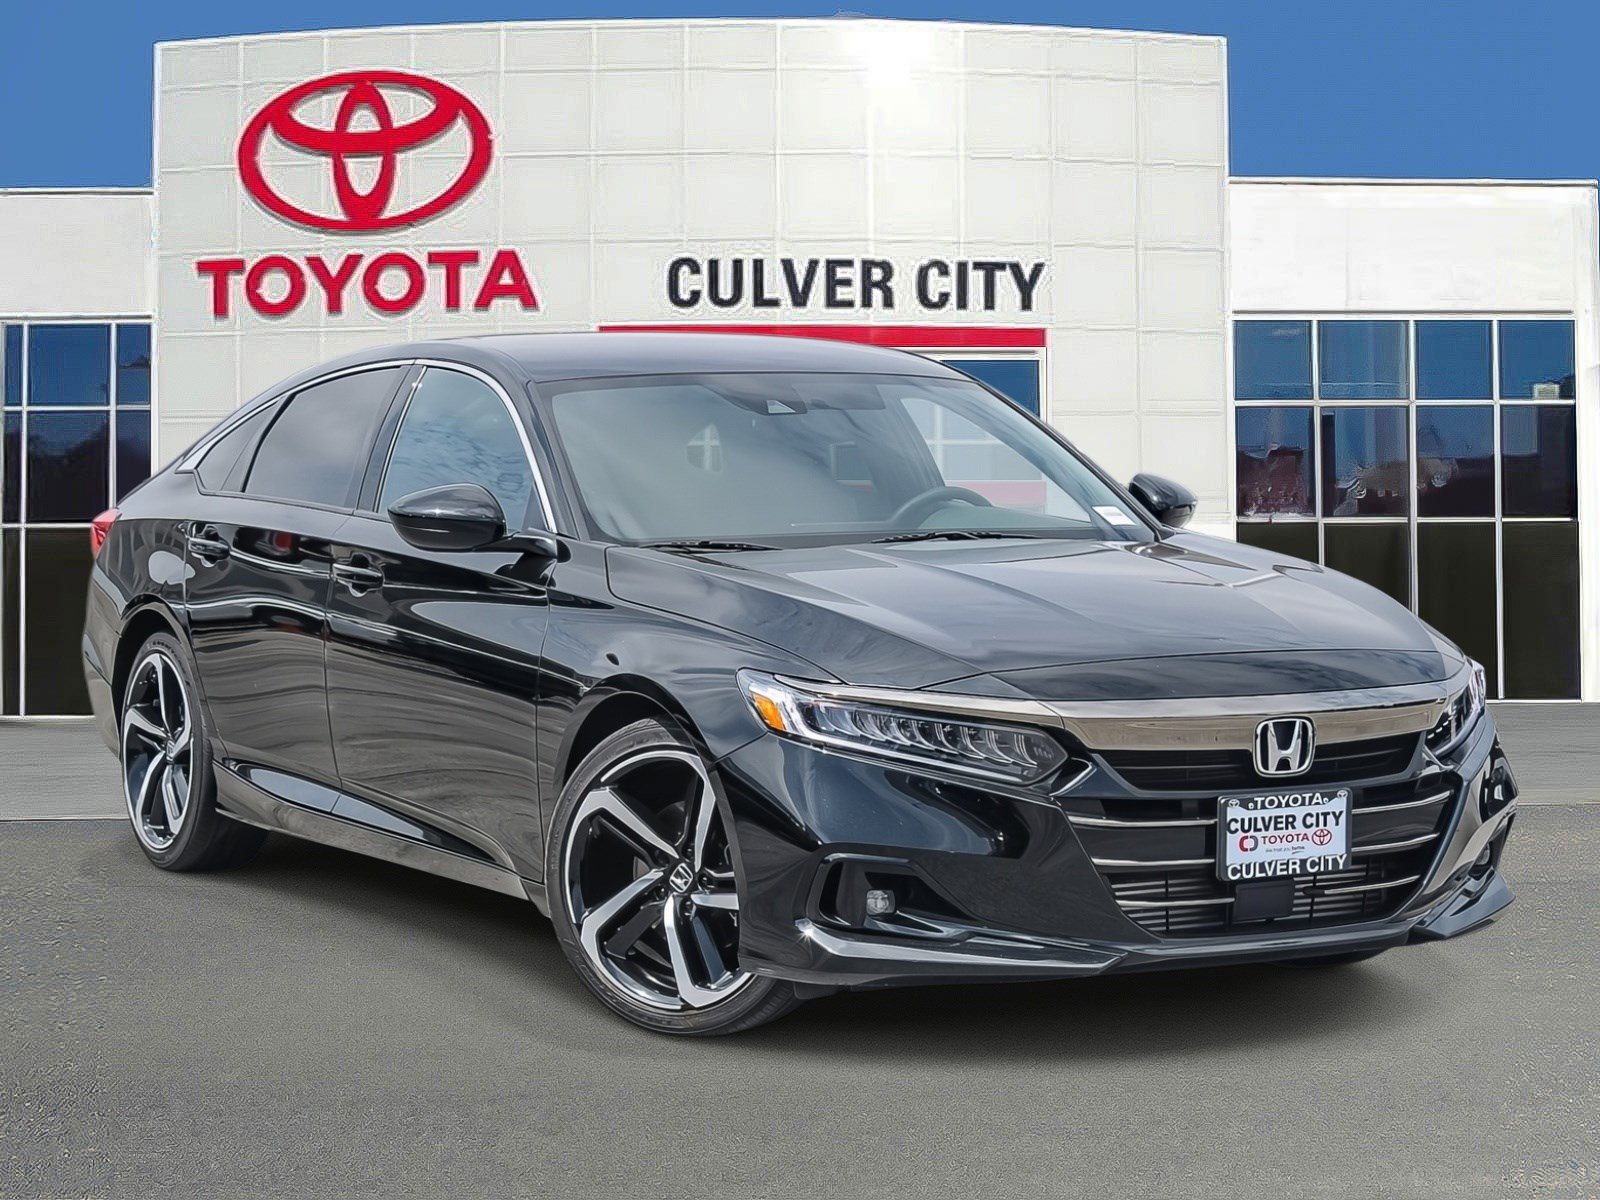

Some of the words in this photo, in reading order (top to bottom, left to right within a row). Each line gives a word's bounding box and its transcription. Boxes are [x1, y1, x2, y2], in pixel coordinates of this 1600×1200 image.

[196, 250, 537, 315] TOYOTA
[669, 258, 893, 308] CULVER
[918, 261, 1043, 310] CITY
[1254, 793, 1323, 809] TOYOTA
[1227, 814, 1296, 834] CULVER
[1302, 811, 1344, 829] CITY
[1262, 833, 1310, 845] TOYOTA
[1228, 859, 1300, 880] CULVER
[1306, 854, 1347, 873] CITY
